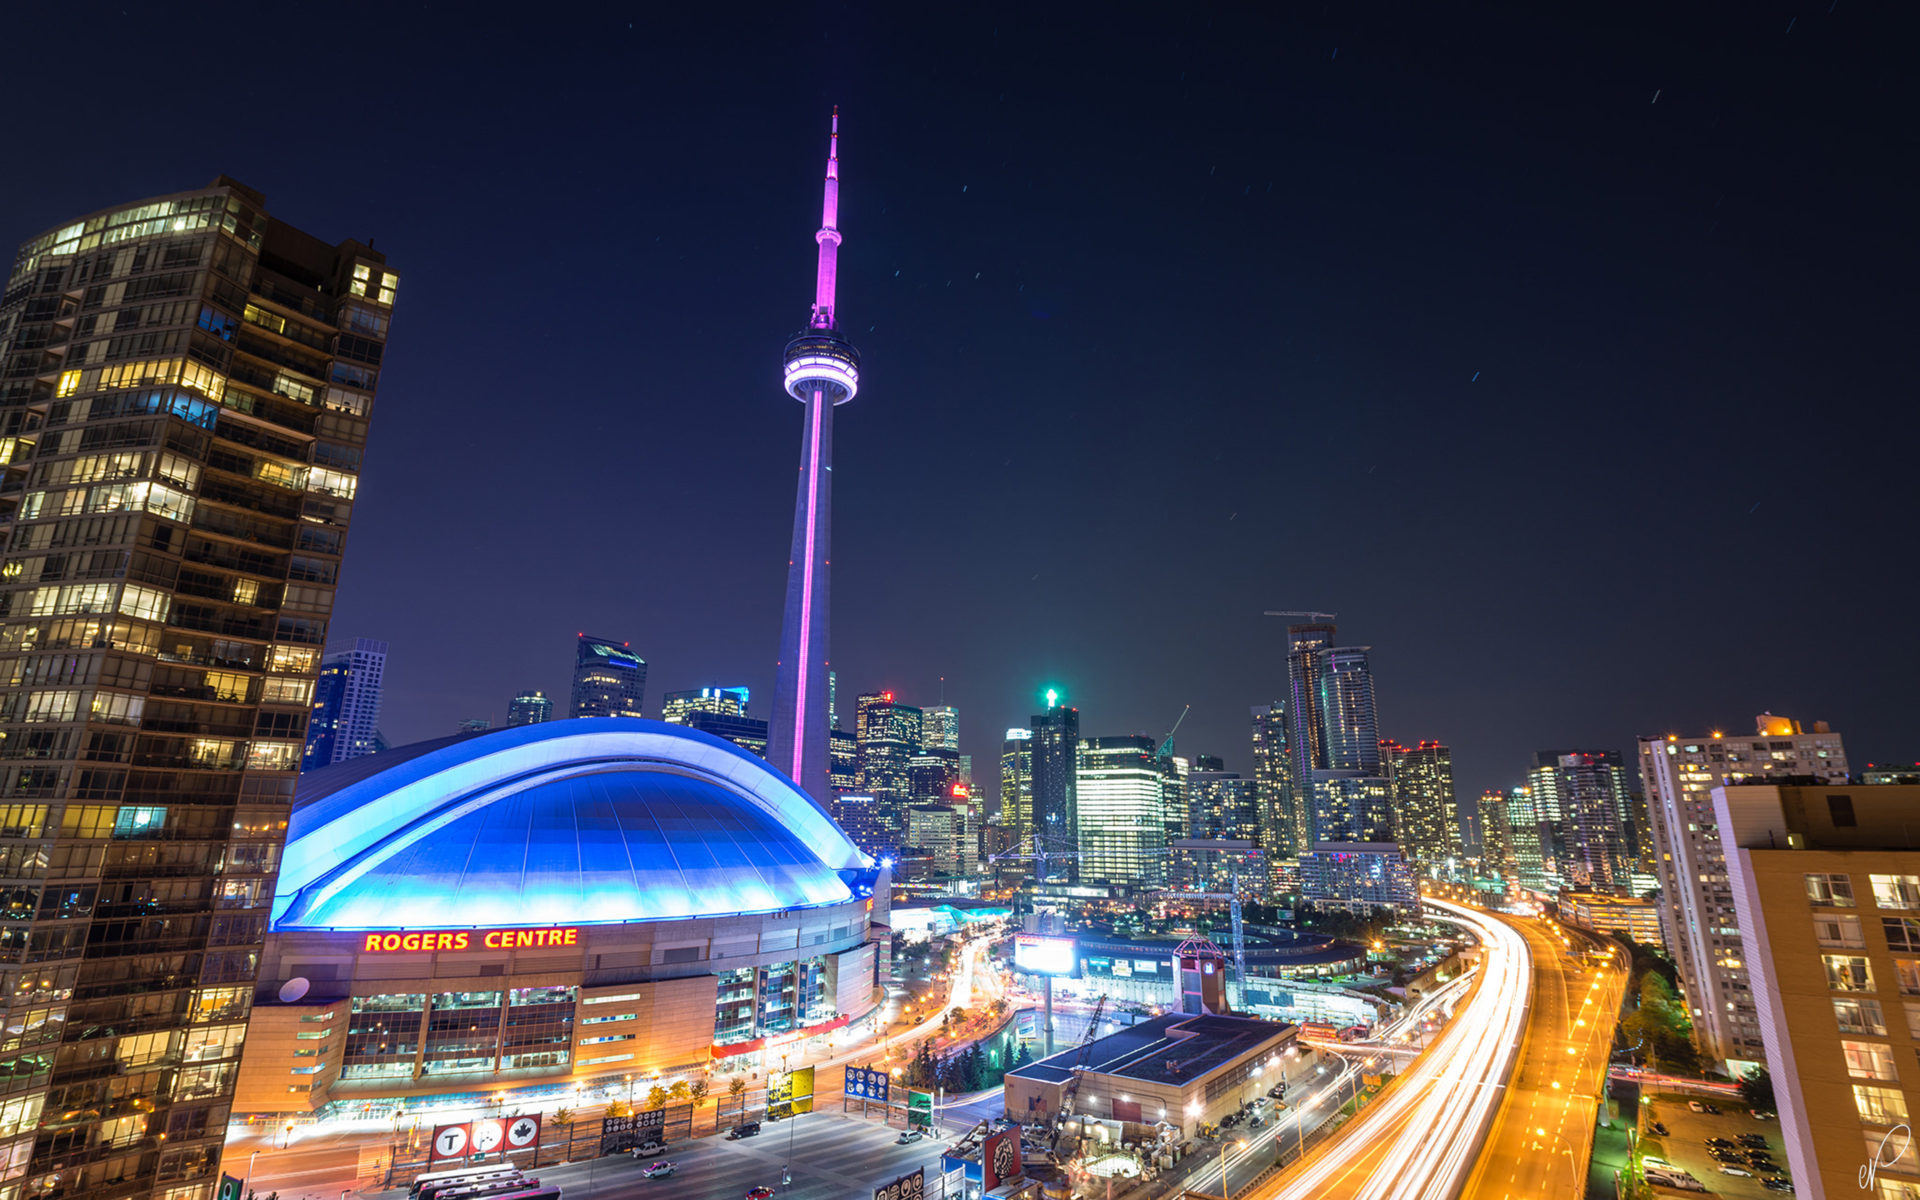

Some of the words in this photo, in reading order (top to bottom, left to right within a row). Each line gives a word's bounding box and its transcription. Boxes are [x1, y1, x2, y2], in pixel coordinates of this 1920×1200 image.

[365, 932, 469, 951] ROGERS
[484, 928, 578, 948] CENTRE
[444, 1134, 459, 1150] T
